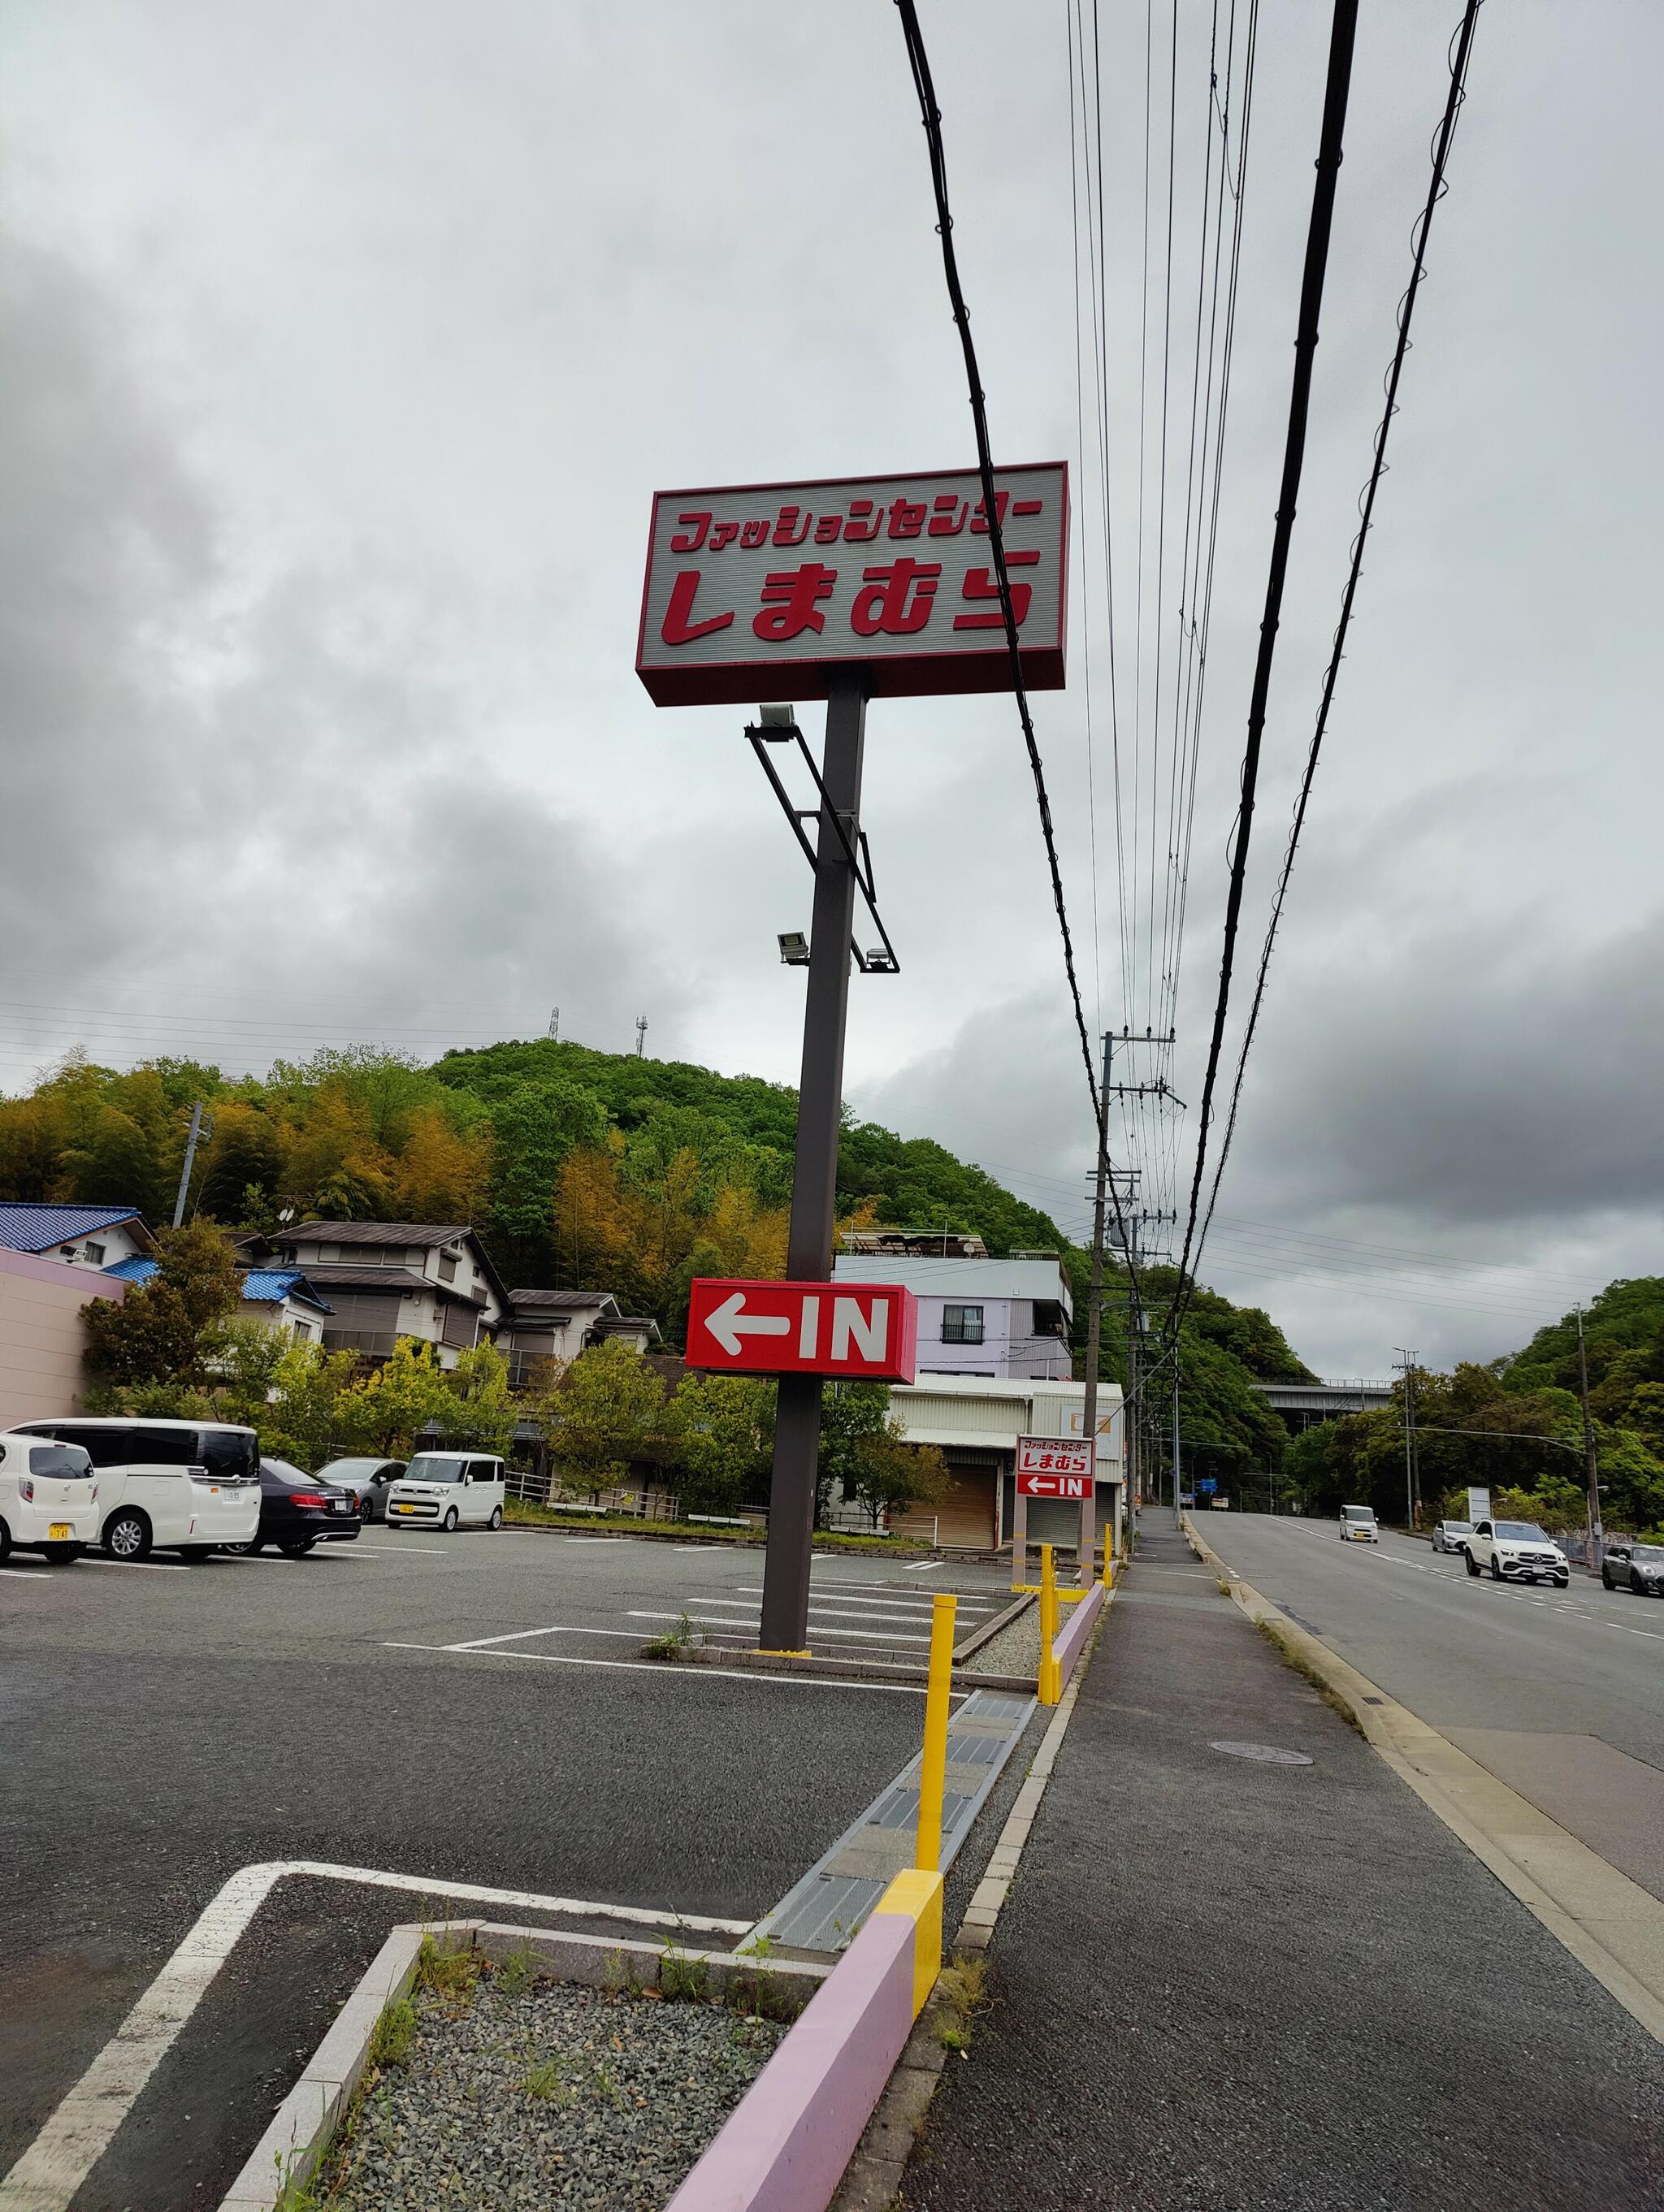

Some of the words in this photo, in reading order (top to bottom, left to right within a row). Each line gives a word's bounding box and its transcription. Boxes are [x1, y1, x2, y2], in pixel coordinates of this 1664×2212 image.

[671, 491, 1042, 552] ファッションセンター
[661, 551, 1041, 644] しまむら
[799, 1296, 889, 1362] IN
[1024, 1452, 1087, 1471] しまむら
[1025, 1440, 1087, 1452] ファッションセンター
[1059, 1478, 1083, 1496] IN
